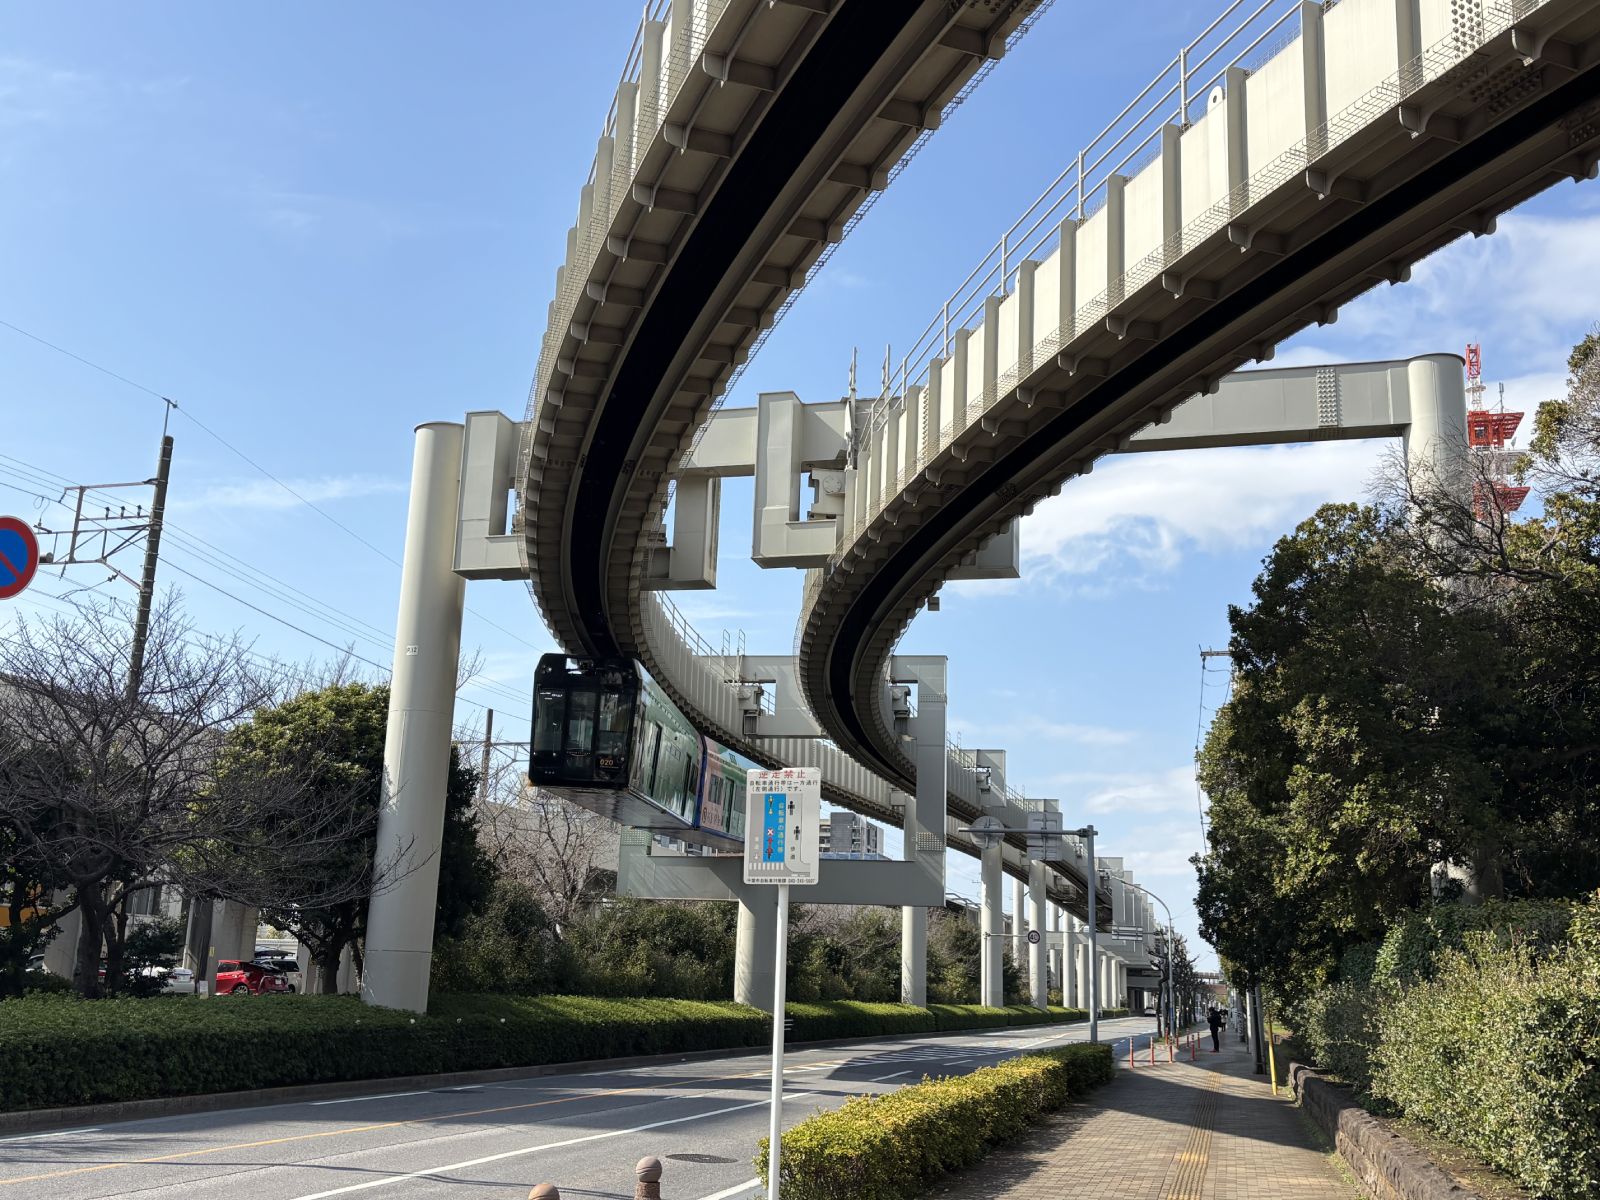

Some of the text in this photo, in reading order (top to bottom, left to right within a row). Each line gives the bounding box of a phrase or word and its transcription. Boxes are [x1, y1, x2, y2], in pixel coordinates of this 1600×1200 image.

[600, 758, 614, 766] 020
[758, 770, 806, 779] 逆走禁止
